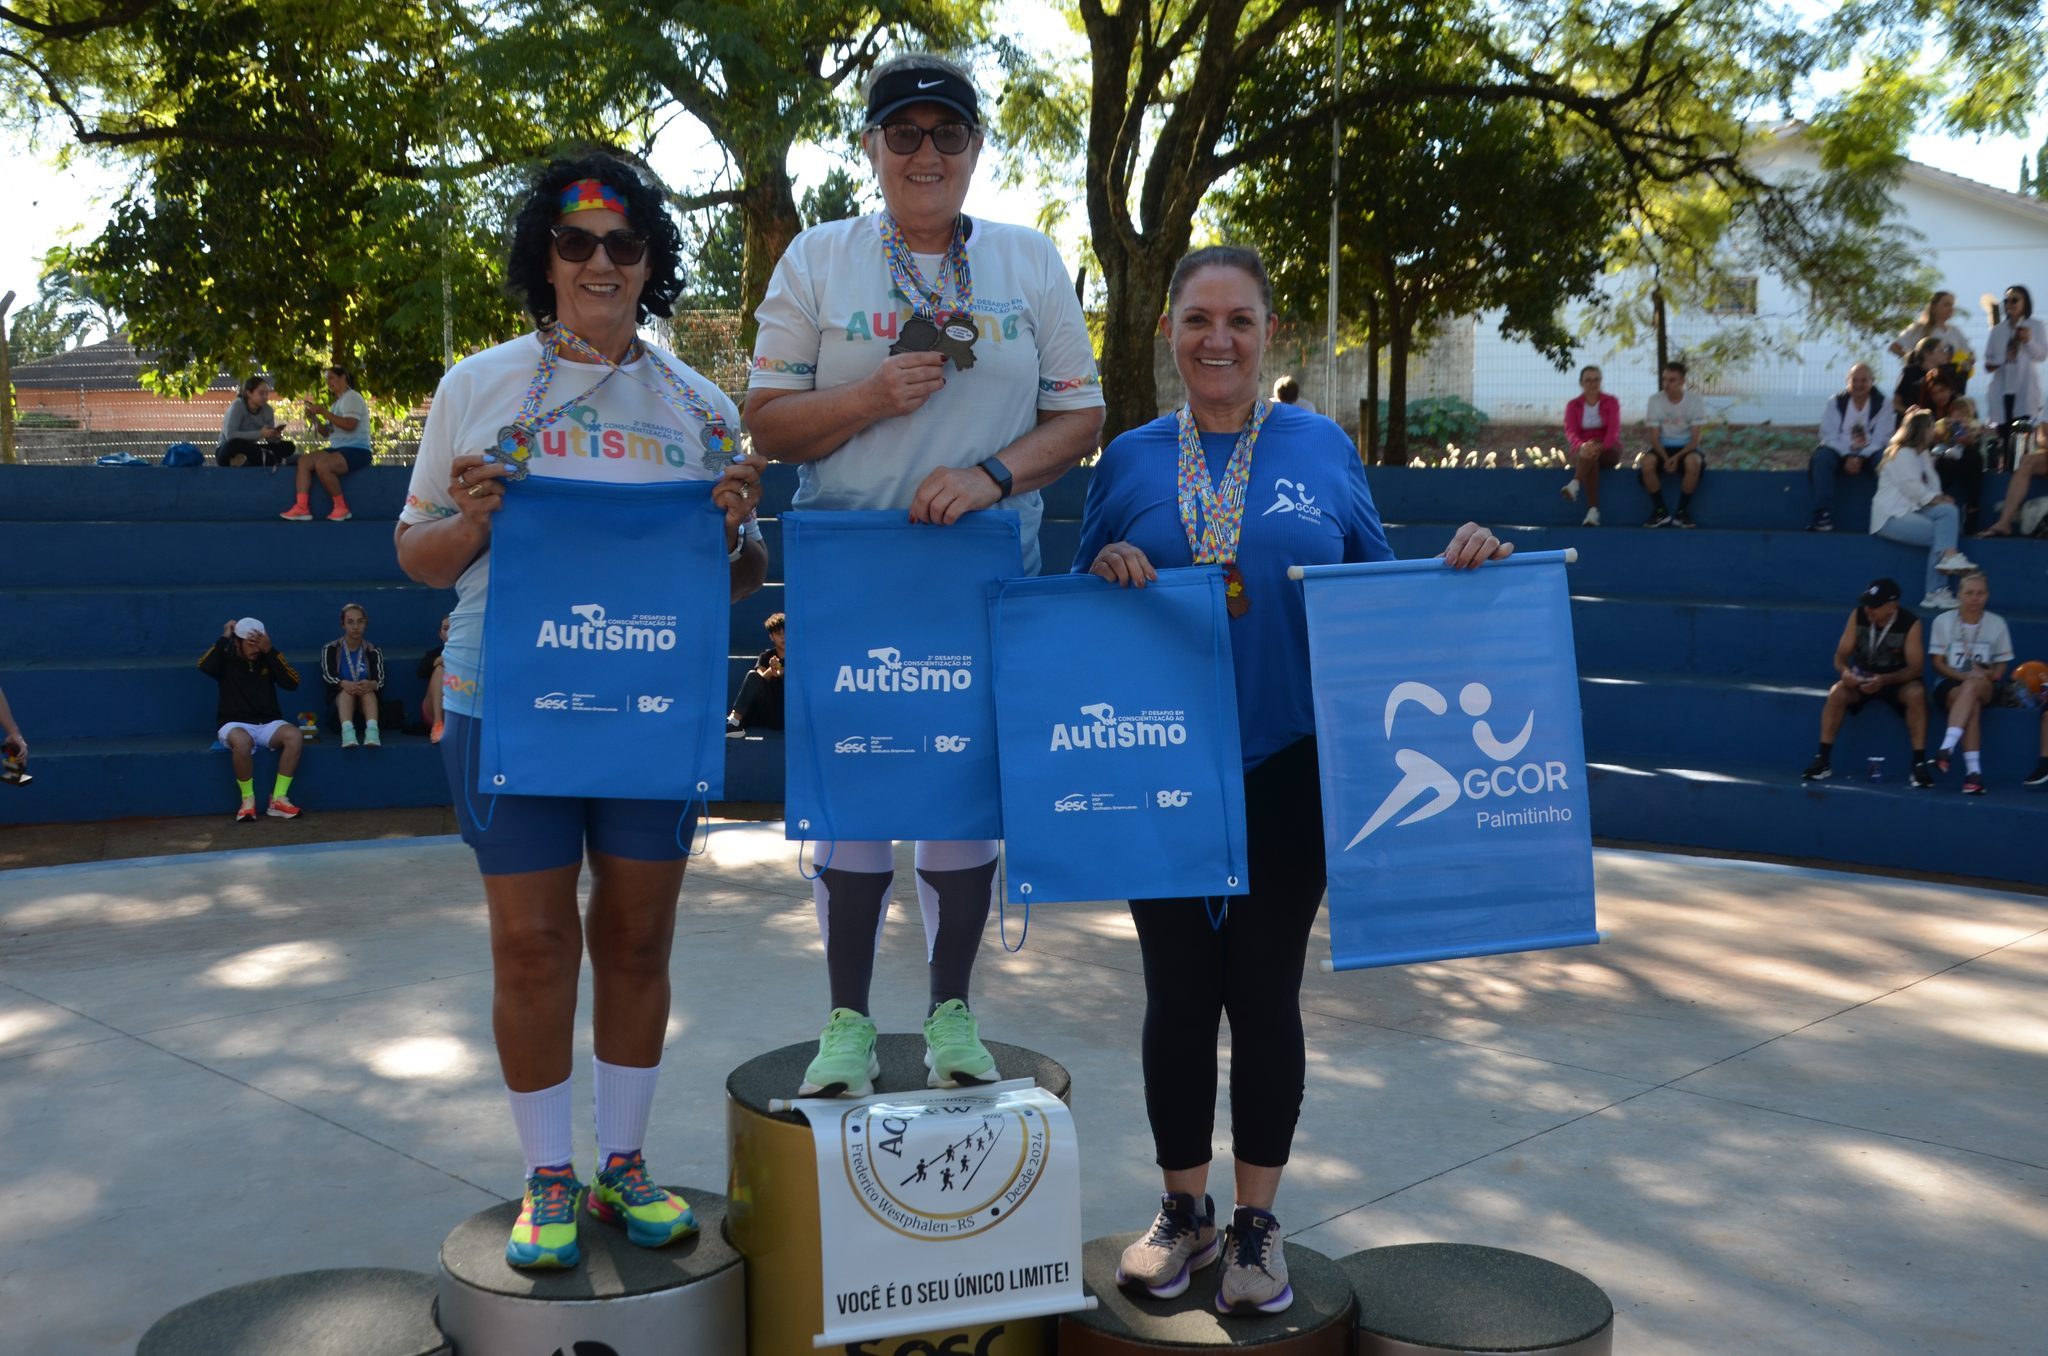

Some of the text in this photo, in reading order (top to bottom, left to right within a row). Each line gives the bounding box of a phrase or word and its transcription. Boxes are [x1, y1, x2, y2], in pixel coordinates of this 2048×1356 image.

[533, 425, 686, 469] utismo
[1295, 503, 1321, 517] GCOR
[536, 620, 677, 651] Autismo
[608, 619, 665, 627] CONSCIENTIZAÇÃO
[834, 664, 972, 692] Autismo
[1050, 721, 1187, 751] Autismo
[1463, 761, 1569, 800] GCOR
[1477, 805, 1572, 829] Palmitinho
[852, 1143, 879, 1201] Frederico
[1004, 1131, 1044, 1204] Desde 2024
[837, 1261, 1070, 1315] VOCÊ É O SEU ÚNICO LIMITE!
